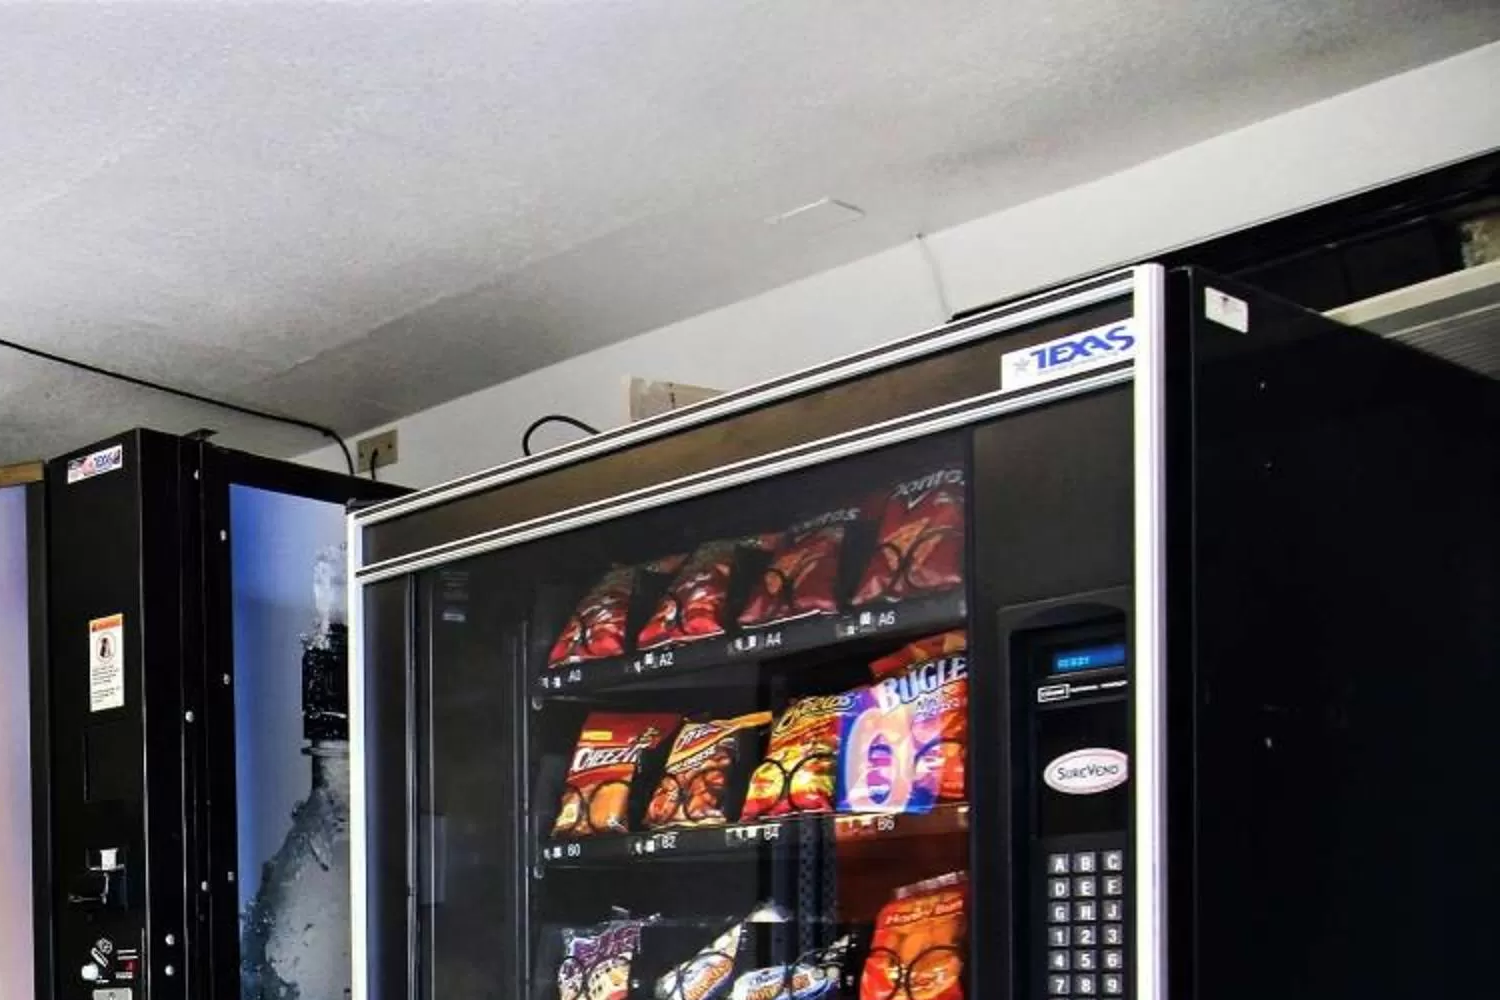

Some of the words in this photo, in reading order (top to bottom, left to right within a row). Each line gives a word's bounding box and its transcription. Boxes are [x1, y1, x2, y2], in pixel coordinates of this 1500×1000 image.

[1030, 325, 1135, 369] TEXAS
[766, 631, 782, 647] A4
[659, 652, 674, 667] A2
[877, 656, 968, 714] BUGLE
